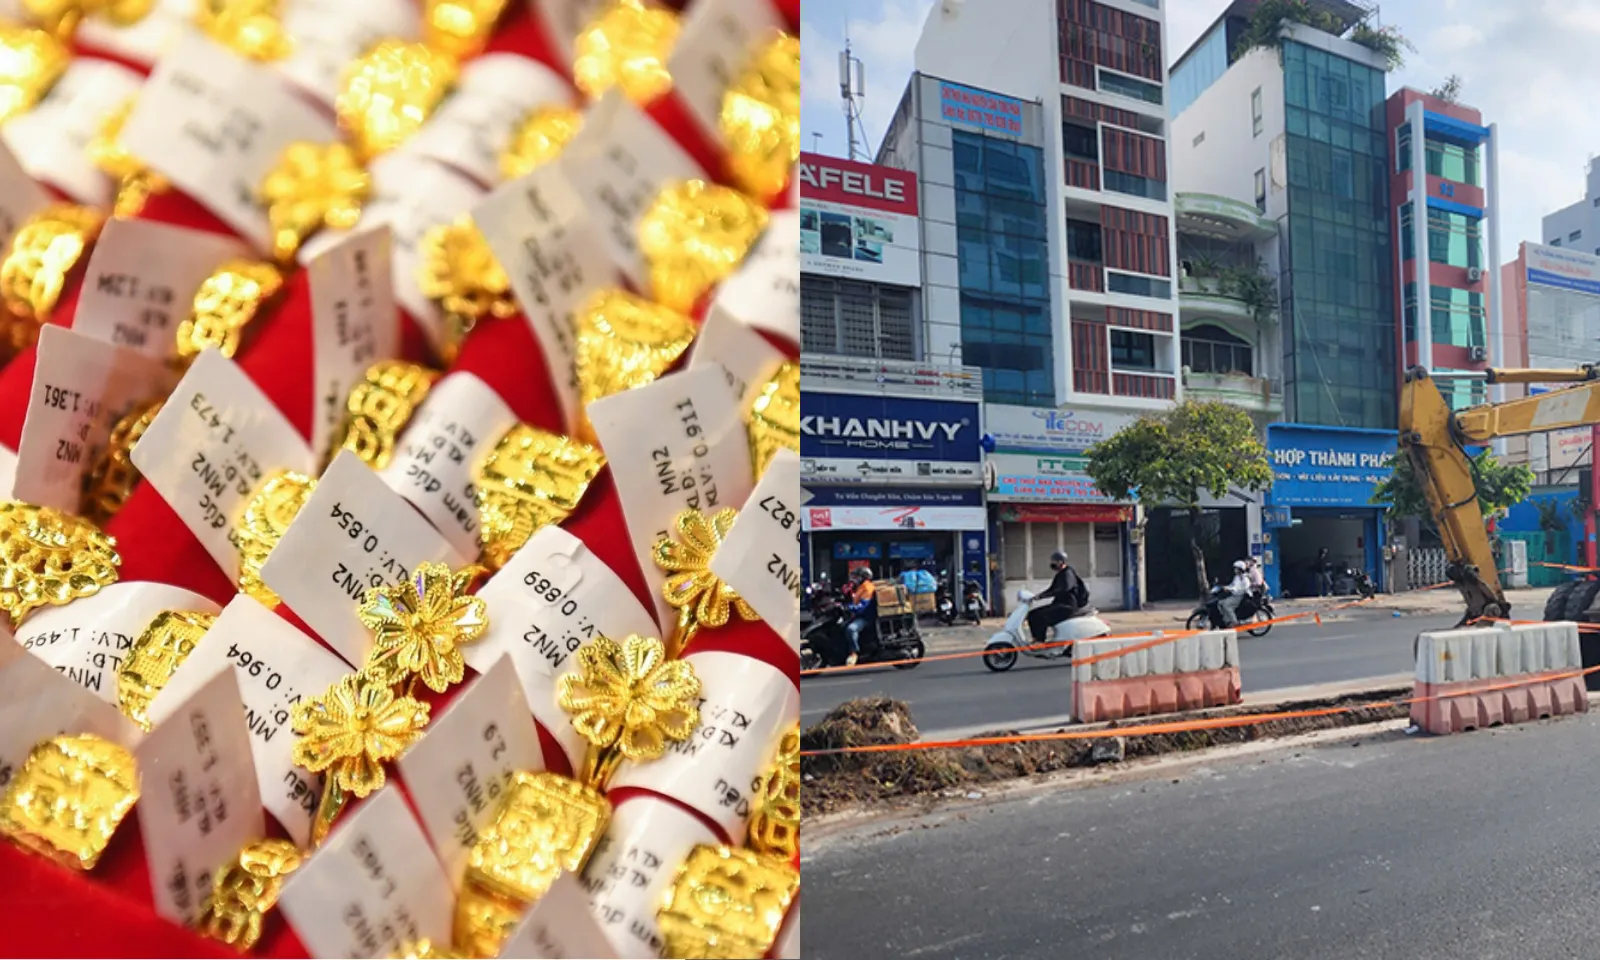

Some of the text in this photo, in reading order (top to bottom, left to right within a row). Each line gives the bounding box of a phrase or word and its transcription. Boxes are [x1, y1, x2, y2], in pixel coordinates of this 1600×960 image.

[45, 384, 82, 412] 1.361
[190, 391, 236, 445] 1.473
[56, 439, 81, 464] MN2
[677, 397, 720, 508] KLV: 0.911
[846, 439, 910, 450] HOME
[1274, 448, 1306, 468] HỢP
[1308, 448, 1356, 467] THÀNH
[191, 451, 228, 499] MN2
[406, 464, 442, 493] đúc
[651, 446, 680, 496] MN2
[199, 493, 226, 529] đúc
[330, 502, 379, 553] 0.854
[332, 562, 368, 605] MN2
[523, 571, 578, 616] 0.889
[767, 552, 800, 599] MN2
[23, 627, 134, 651] KLV: 1.499
[523, 624, 568, 668] MN2
[86, 651, 123, 672] LĐ:
[226, 643, 282, 690] 0.964
[242, 703, 278, 743] MN
[482, 720, 507, 761] 2.9
[456, 763, 488, 816] MN2
